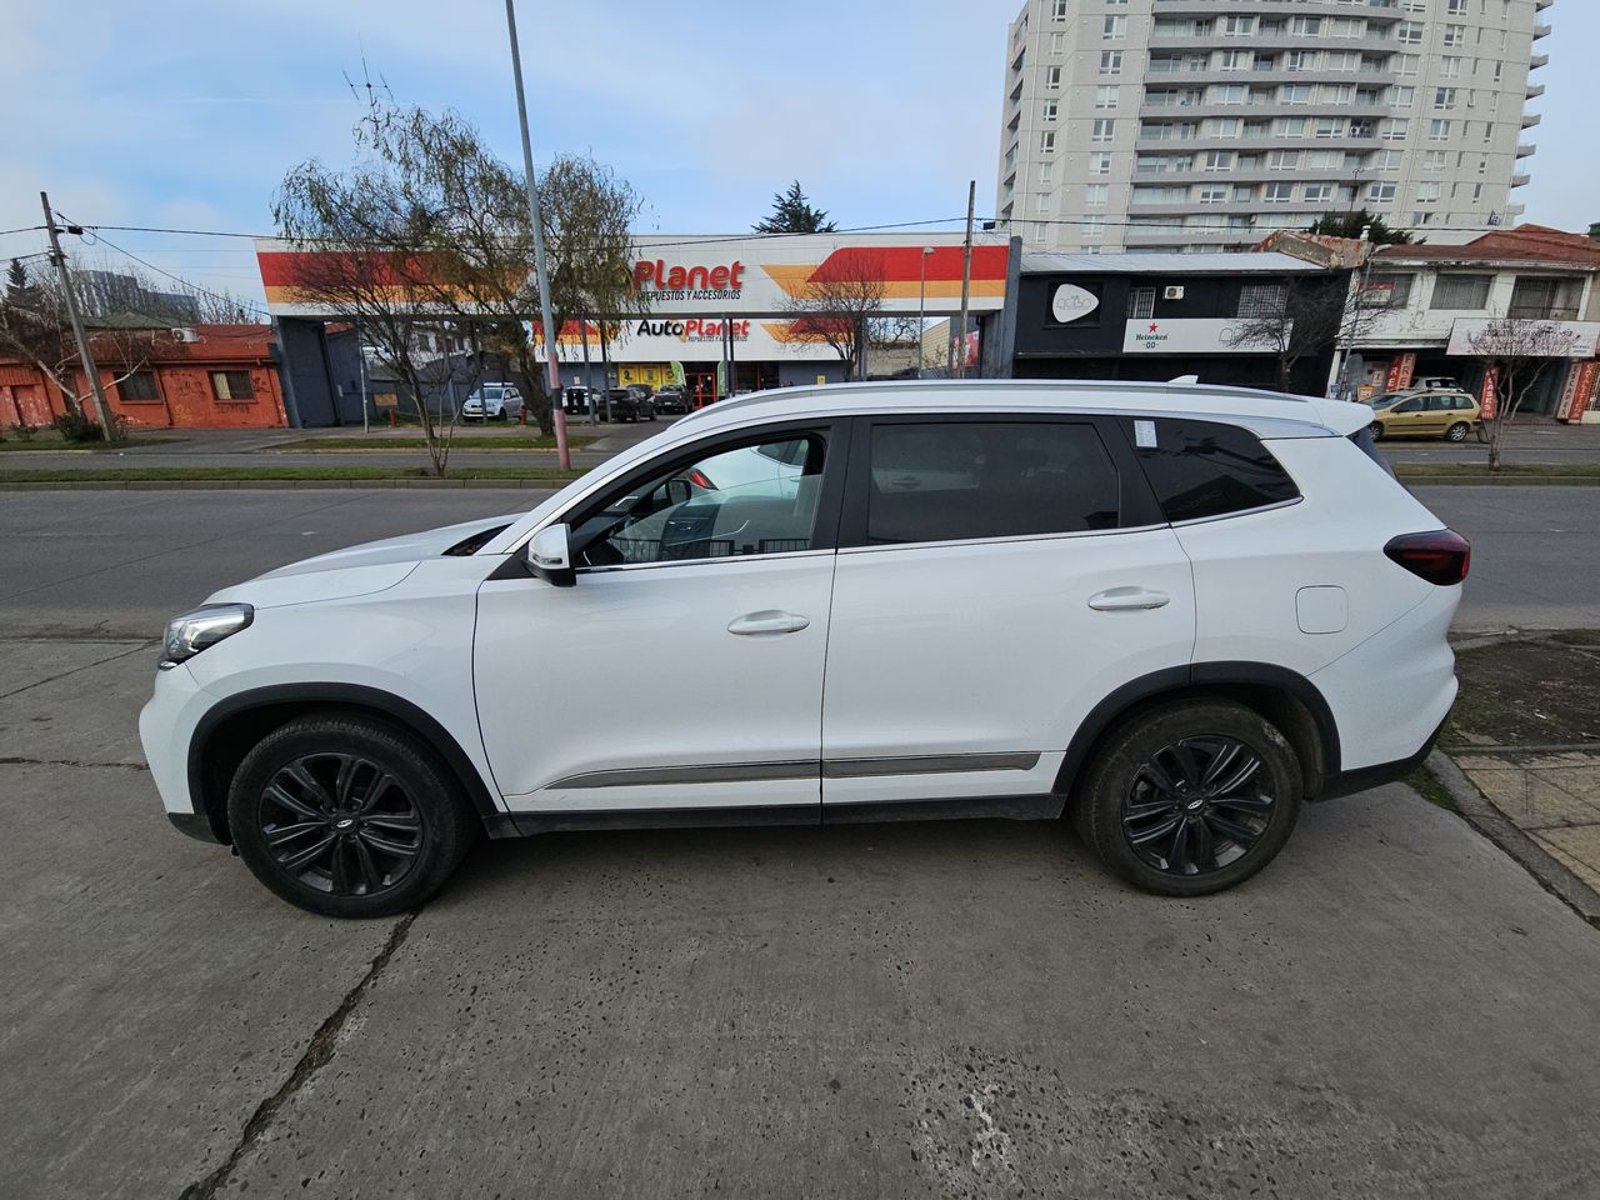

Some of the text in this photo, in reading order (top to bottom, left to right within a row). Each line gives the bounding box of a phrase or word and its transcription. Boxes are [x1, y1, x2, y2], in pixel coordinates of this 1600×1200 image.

[633, 259, 746, 290] Planet
[687, 290, 693, 300] Y
[693, 289, 741, 300] ACCESORIOS
